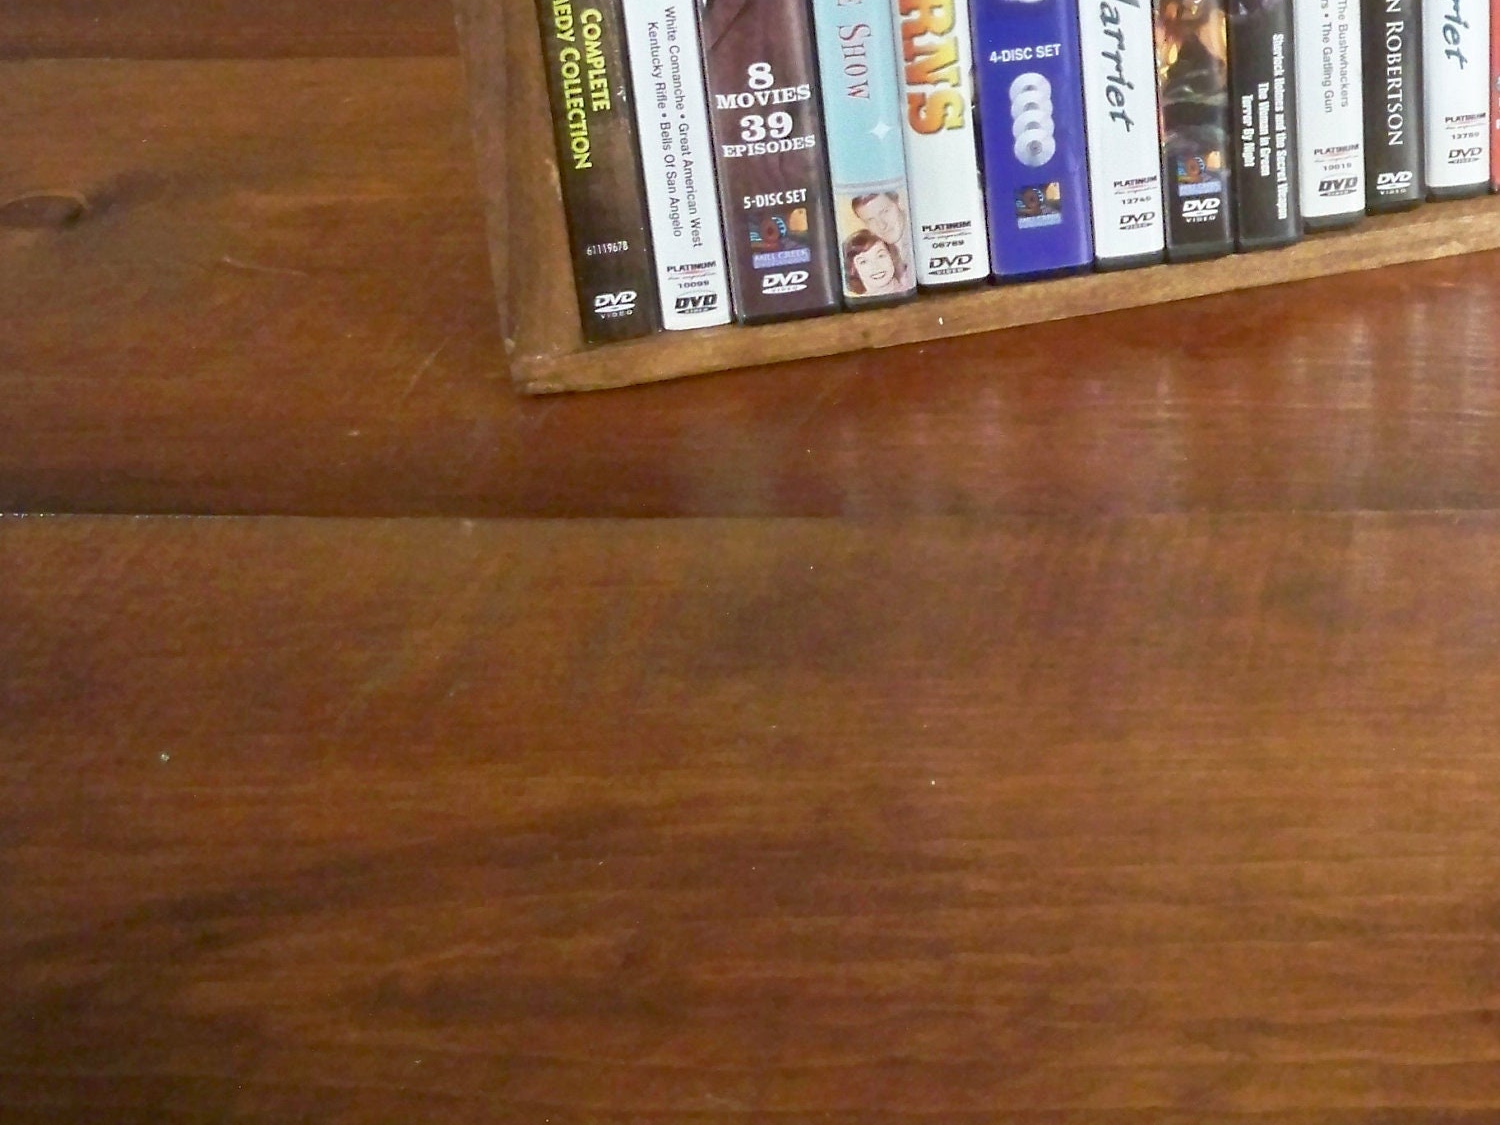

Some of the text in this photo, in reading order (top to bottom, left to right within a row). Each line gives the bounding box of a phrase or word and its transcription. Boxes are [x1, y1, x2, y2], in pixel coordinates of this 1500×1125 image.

[579, 8, 611, 112] COMPLETE
[839, 24, 873, 100] SHOW
[989, 43, 1062, 63] 4-DISC SET
[747, 62, 774, 90] 8
[1386, 21, 1405, 146] ROBERTSON
[560, 47, 592, 169] COLLECTION
[715, 84, 812, 110] MOVIES
[648, 21, 684, 237] Kentucky Rifle Bells Of San Angelo
[664, 6, 704, 247] White Comanche Great American West
[740, 111, 794, 143] 39
[721, 135, 816, 158] EPISODES
[743, 189, 807, 209] 5-DISC SET
[762, 270, 809, 287] DVD
